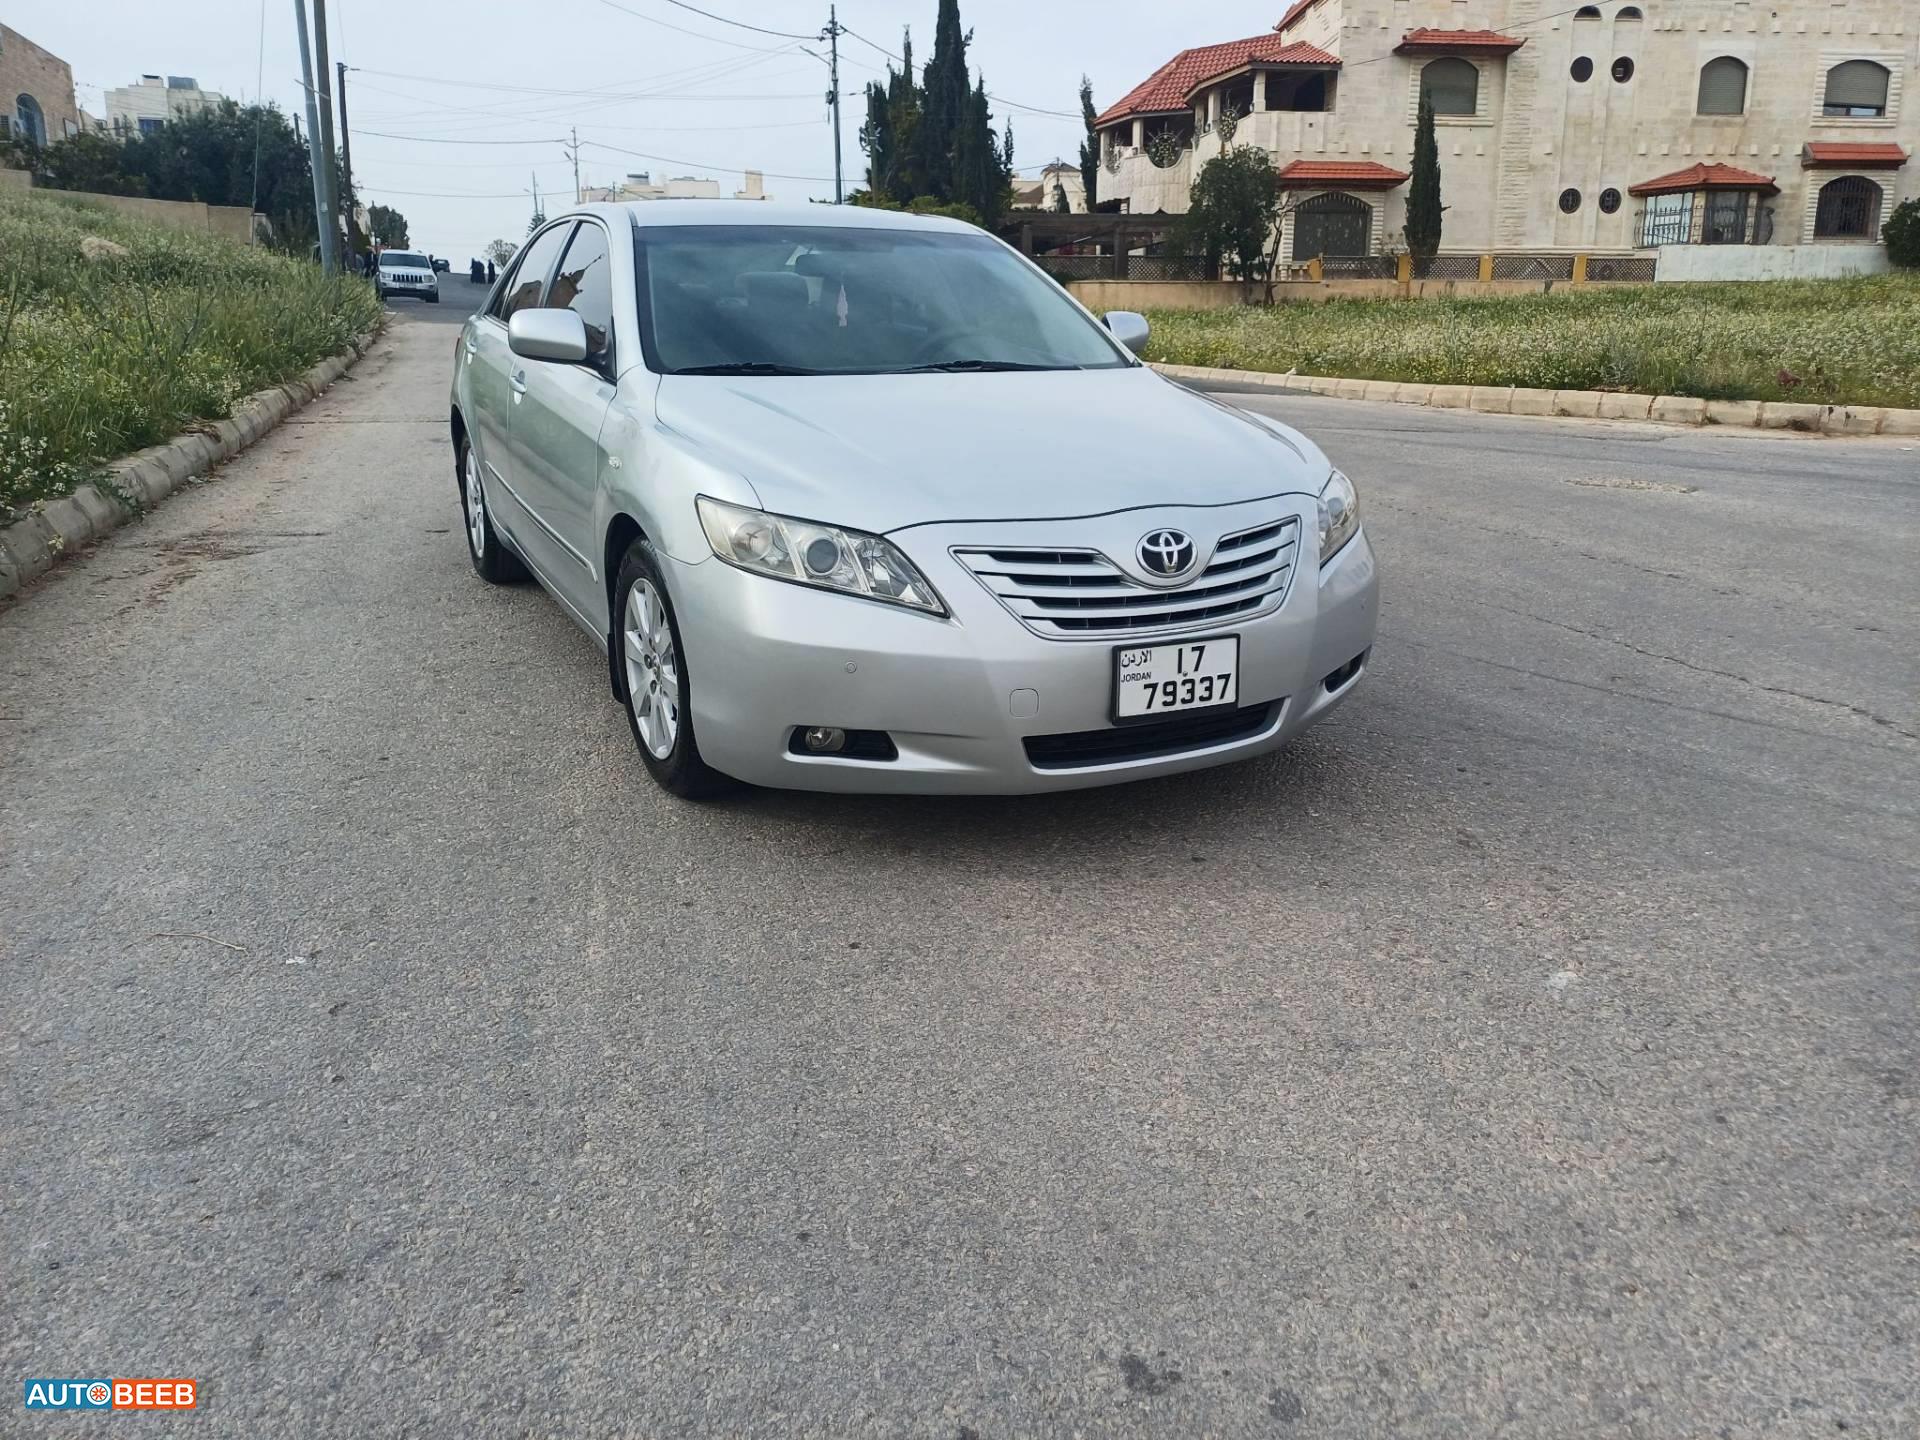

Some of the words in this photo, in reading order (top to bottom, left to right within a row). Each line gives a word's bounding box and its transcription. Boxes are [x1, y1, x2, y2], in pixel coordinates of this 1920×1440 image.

[1177, 645, 1206, 674] 17
[1121, 671, 1152, 683] JORDAN
[1143, 673, 1232, 709] 79337
